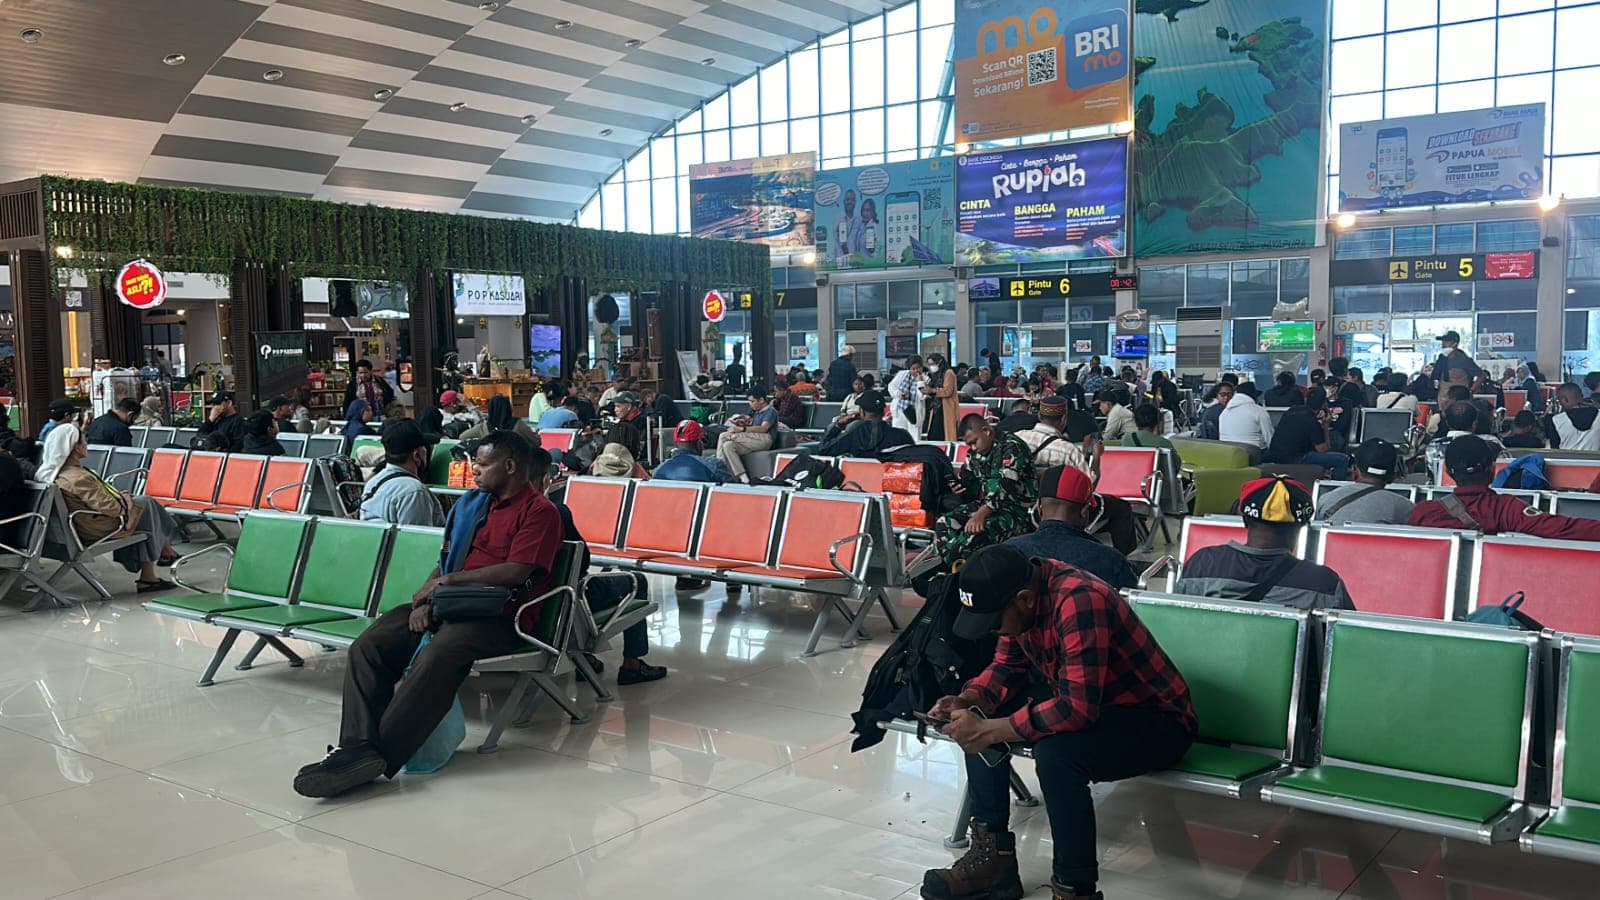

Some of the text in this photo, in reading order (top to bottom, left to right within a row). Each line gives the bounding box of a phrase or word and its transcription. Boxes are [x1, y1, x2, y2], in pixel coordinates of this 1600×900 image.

[977, 7, 1057, 57] mo
[1074, 24, 1119, 57] BRI
[982, 55, 1024, 74] Scan QR
[1084, 51, 1121, 72] mo
[974, 79, 1024, 97] Sekarang!
[1428, 129, 1475, 148] DOWNLOAD
[1452, 149, 1485, 160] PAPUA
[1488, 147, 1523, 157] MOBILE
[992, 162, 1086, 199] Rupiah
[960, 199, 991, 210] CINTA
[1014, 203, 1056, 215] BANGGA
[1066, 205, 1105, 217] PAHAM
[1415, 260, 1447, 270] Pintu
[1458, 257, 1473, 278] 5
[1028, 278, 1070, 295] Pintu 6
[489, 291, 522, 301] KASUARI
[776, 292, 785, 306] 7
[1338, 319, 1385, 332] GATE 5
